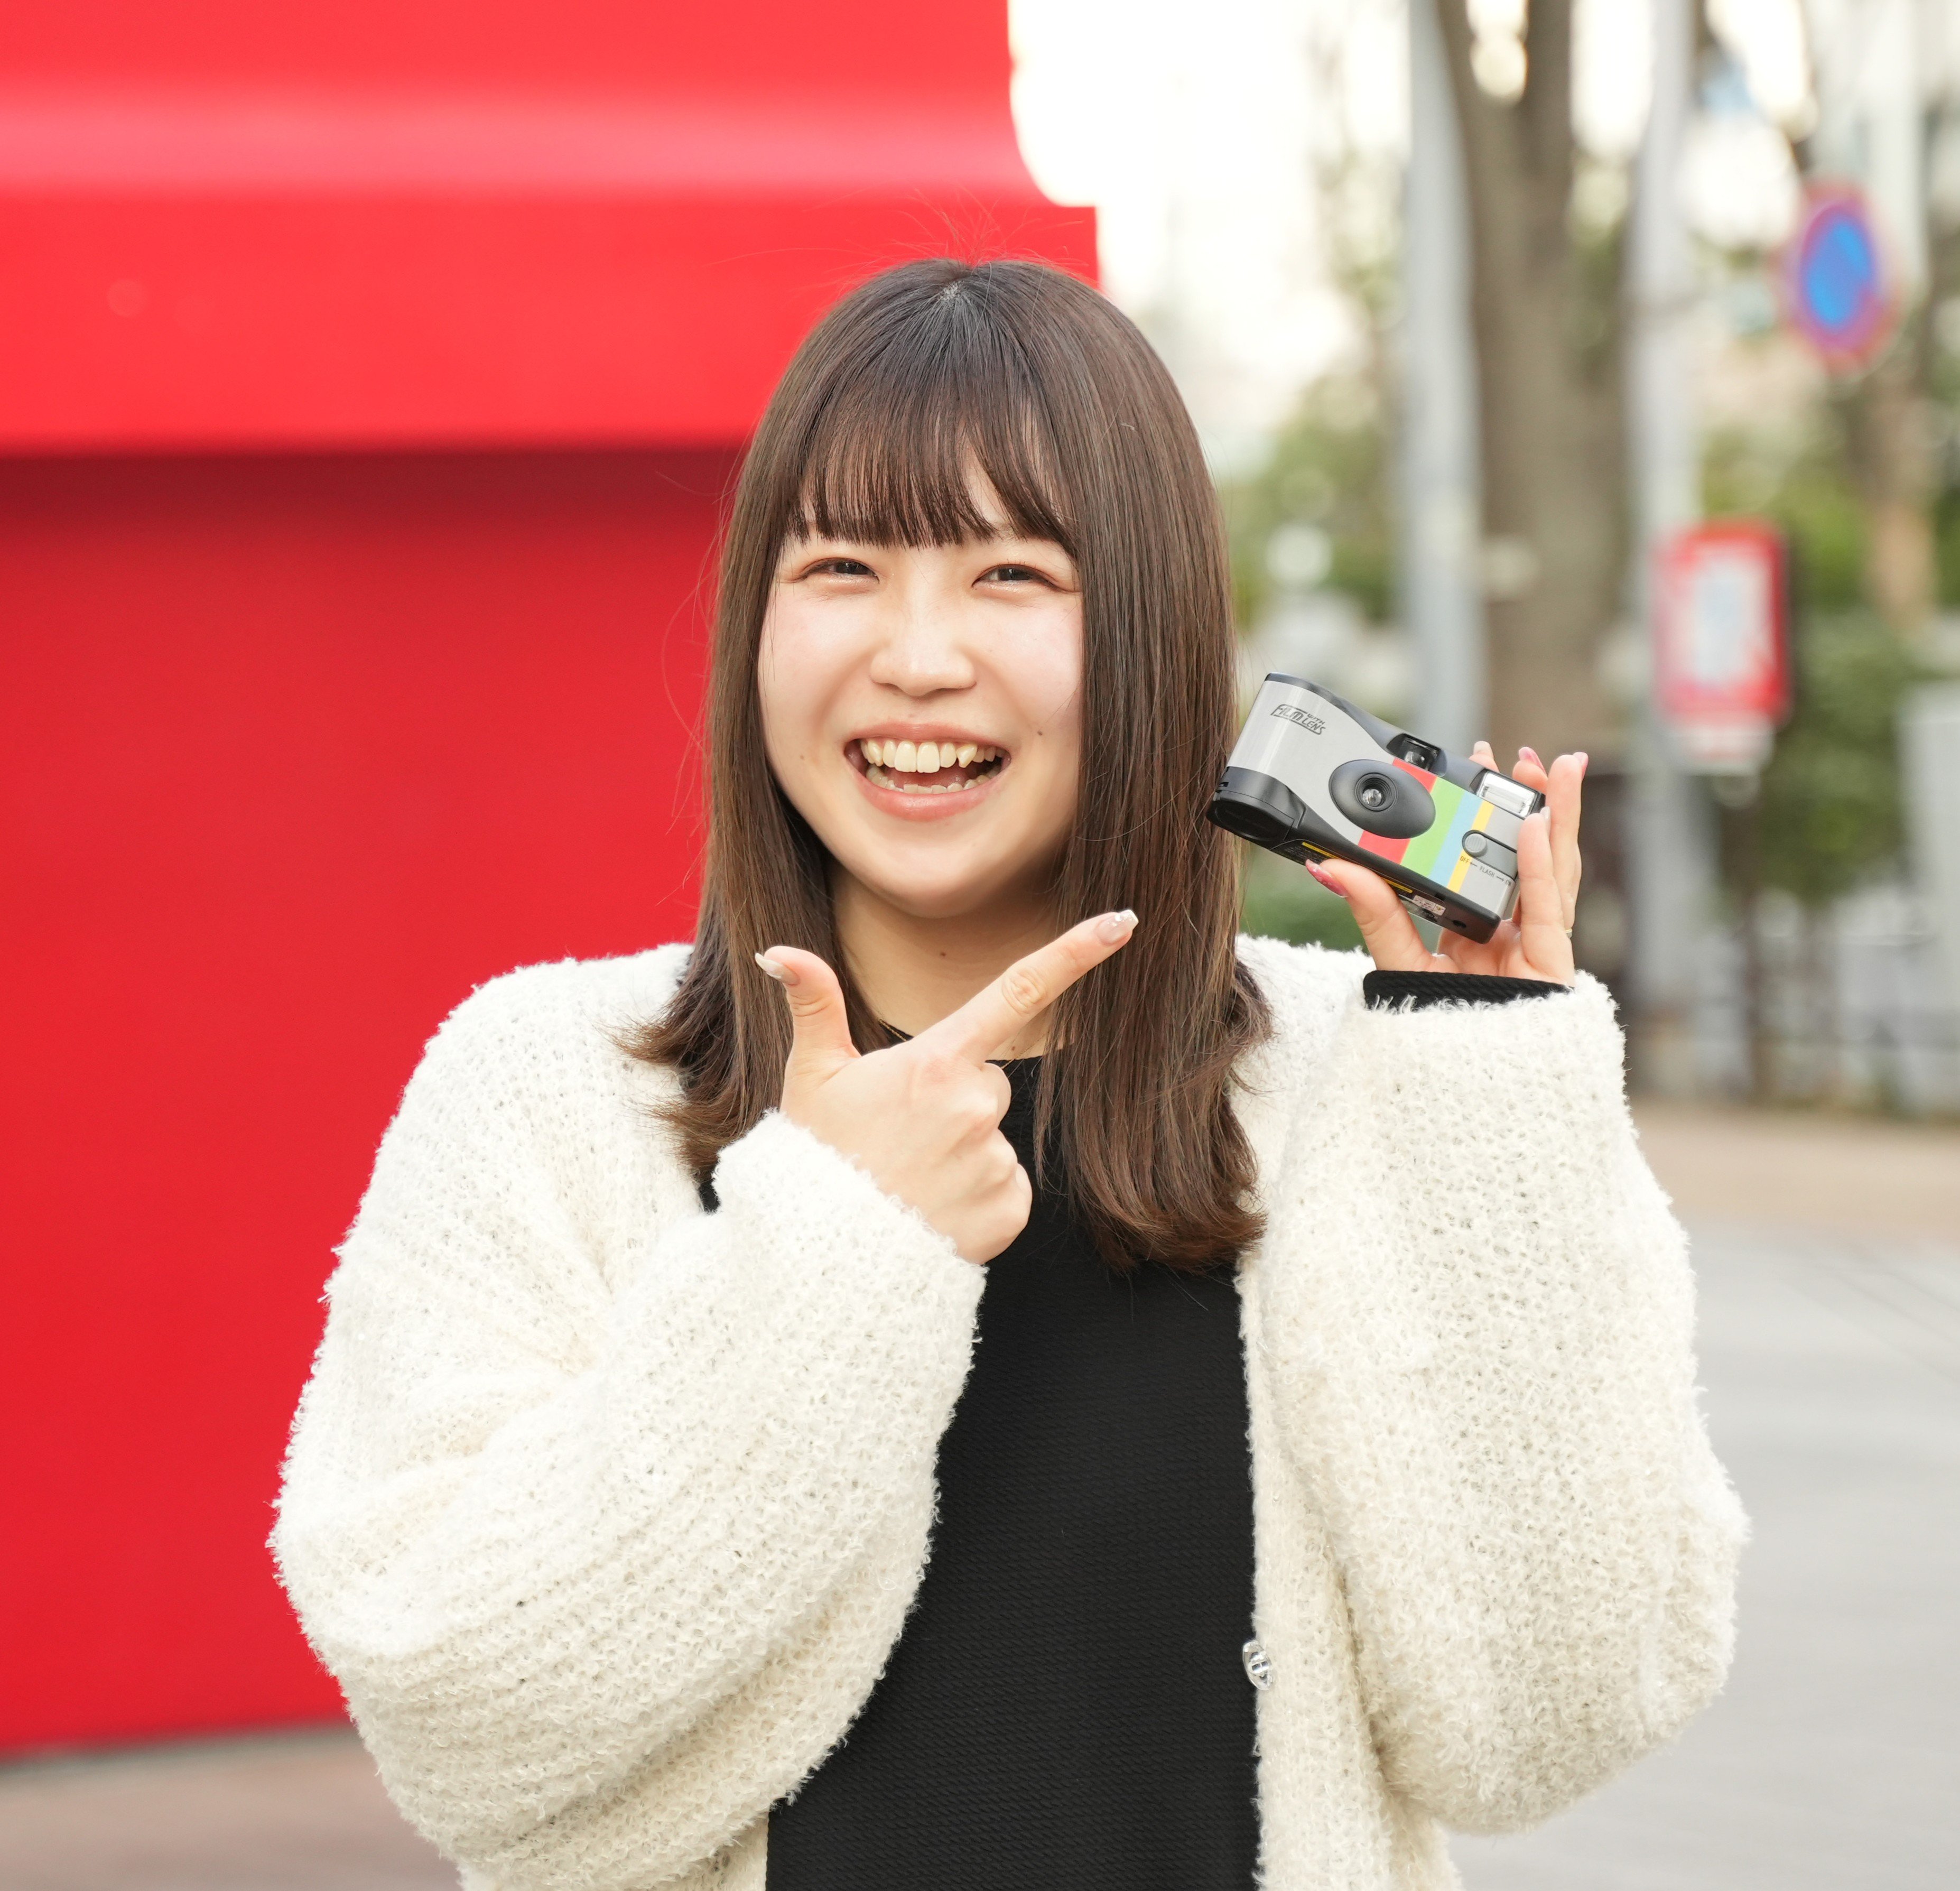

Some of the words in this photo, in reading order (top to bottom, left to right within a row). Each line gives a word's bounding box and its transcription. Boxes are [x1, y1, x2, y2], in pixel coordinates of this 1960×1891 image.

[1270, 704, 1305, 721] FILM
[1307, 713, 1325, 725] WITH
[1302, 718, 1326, 735] LENS
[1480, 866, 1495, 877] FLASH
